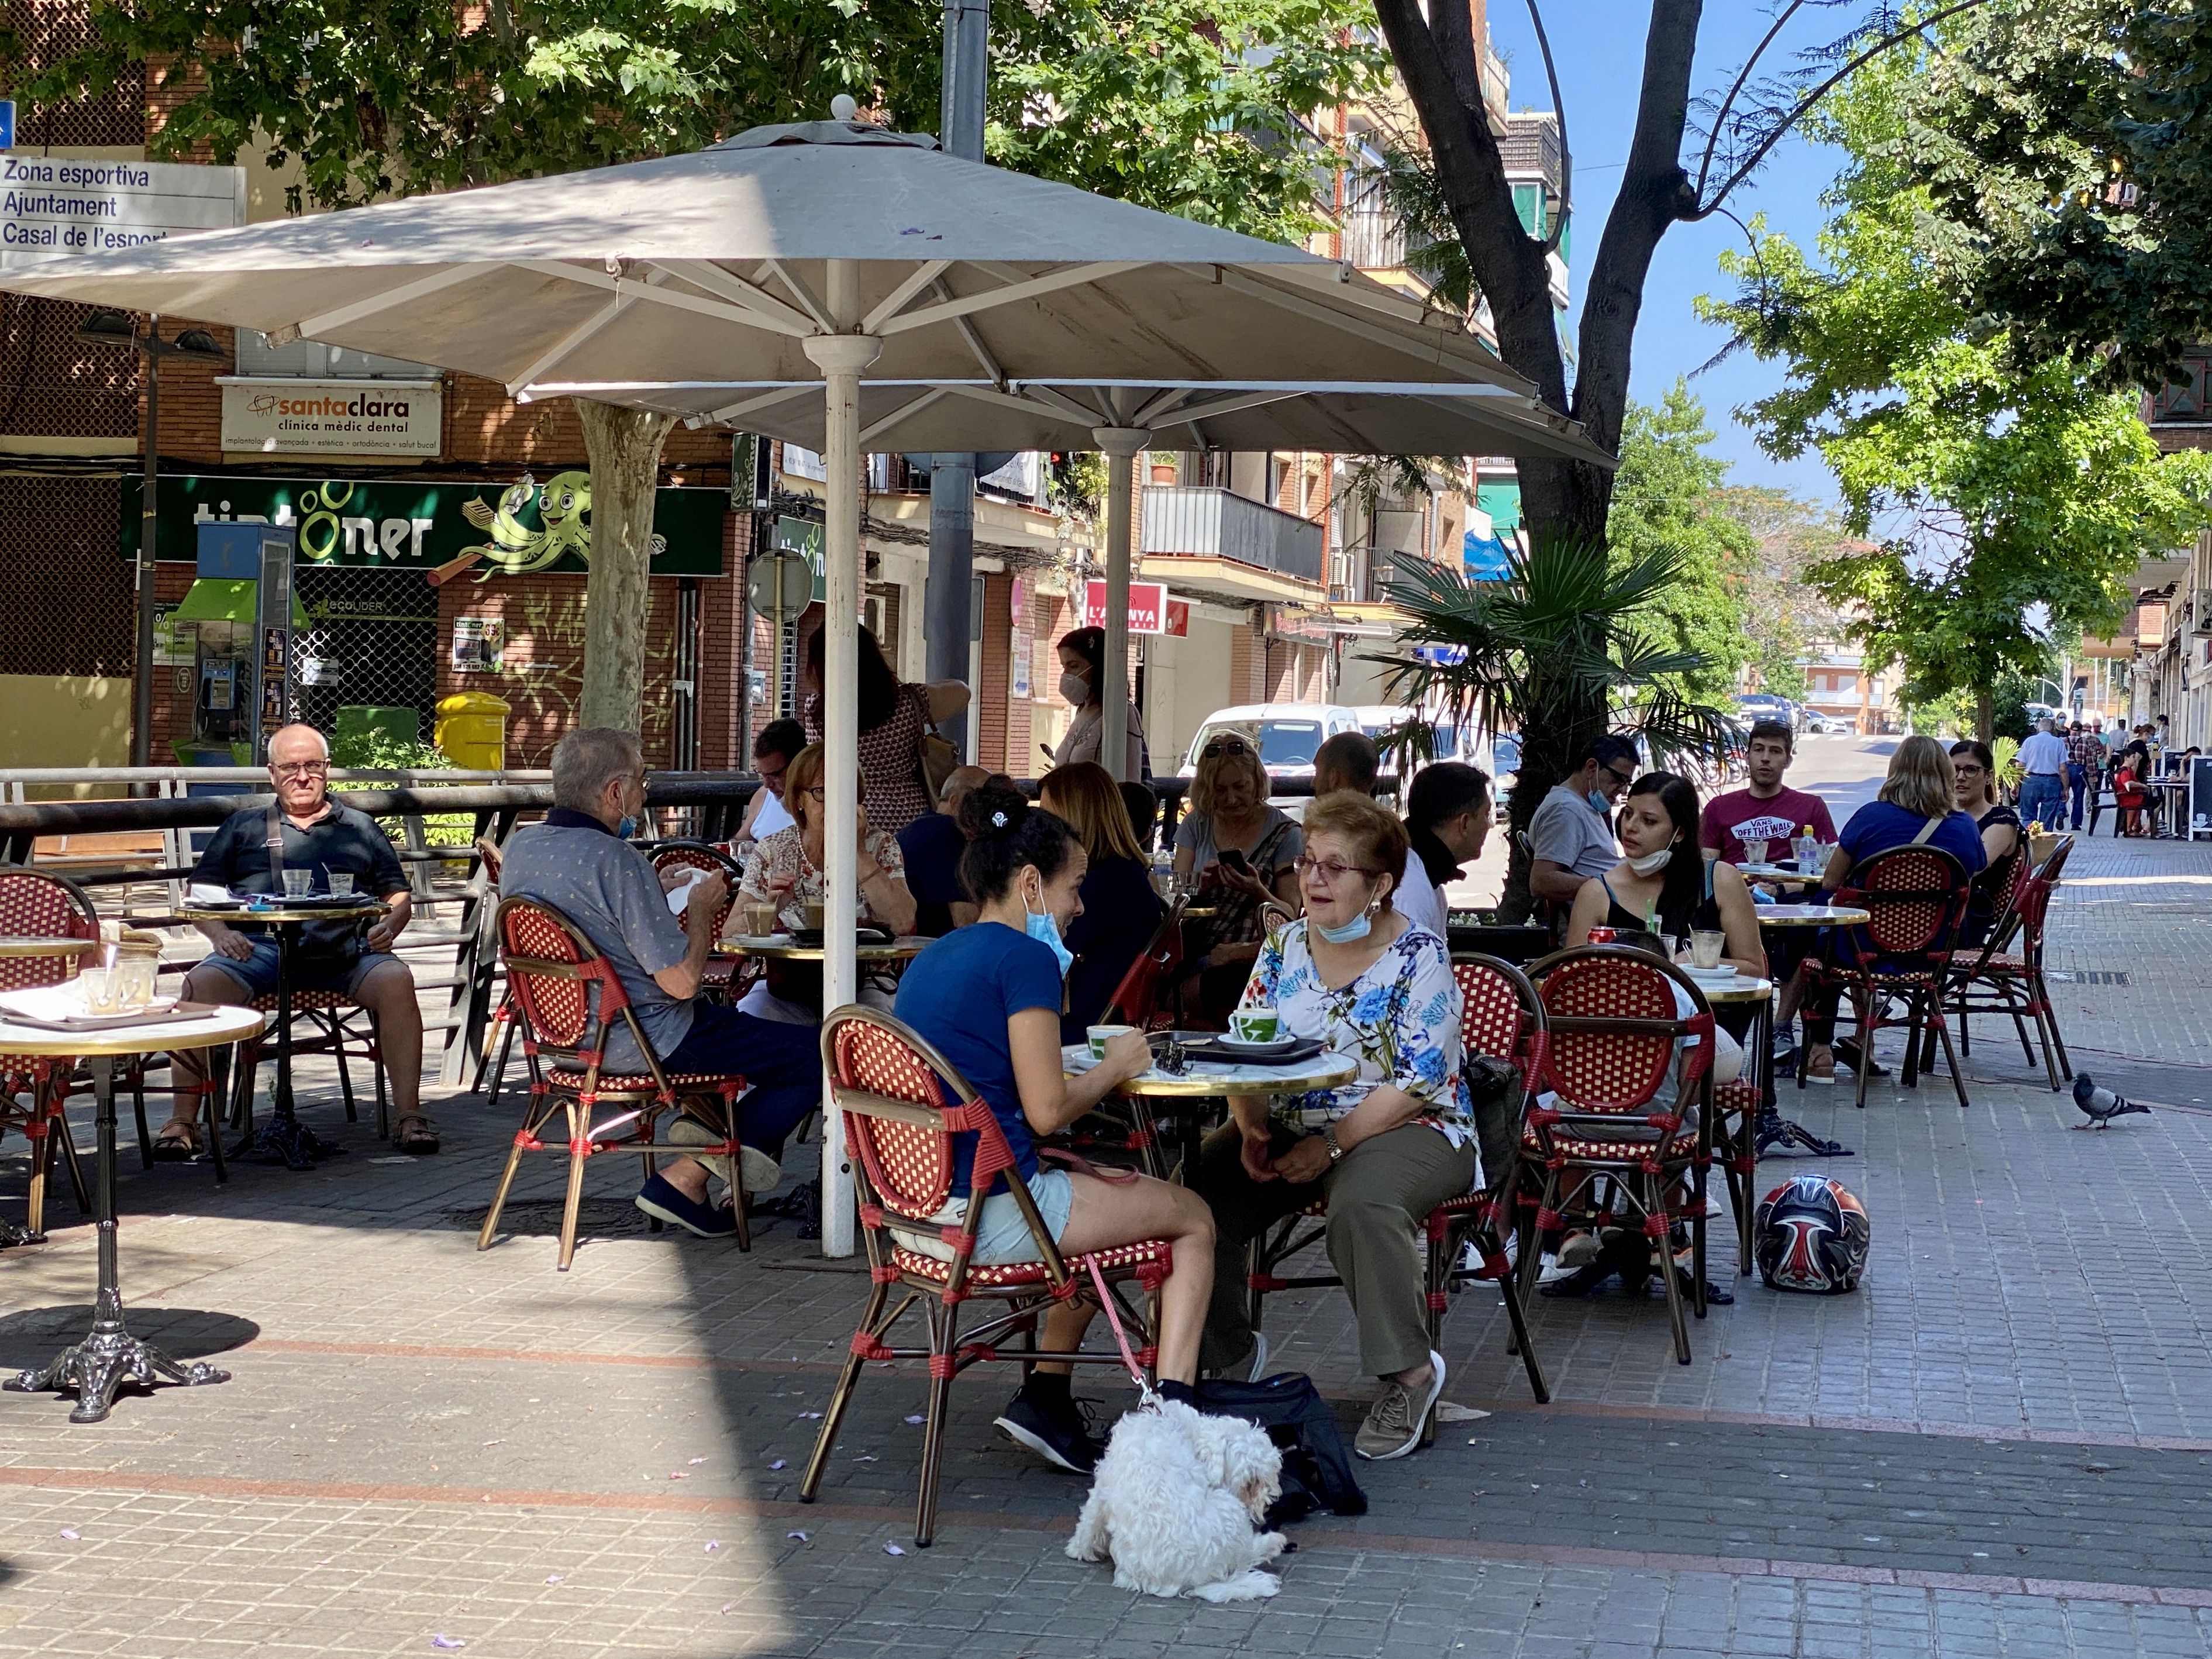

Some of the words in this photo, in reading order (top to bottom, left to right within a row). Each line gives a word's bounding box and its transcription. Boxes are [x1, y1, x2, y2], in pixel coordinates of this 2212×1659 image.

[4, 160, 52, 182] Zona
[60, 165, 149, 188] esportiva
[4, 191, 116, 216] Ajuntament
[4, 223, 57, 245] Casal
[64, 226, 87, 247] de
[278, 393, 409, 417] santaclara
[278, 419, 319, 431] clínica
[325, 421, 361, 431] mèdic
[367, 421, 408, 432] dental
[417, 440, 436, 449] bucal
[1089, 606, 1155, 622] L'ANYA
[1751, 817, 1773, 827] VANS
[1752, 827, 1769, 837] THE
